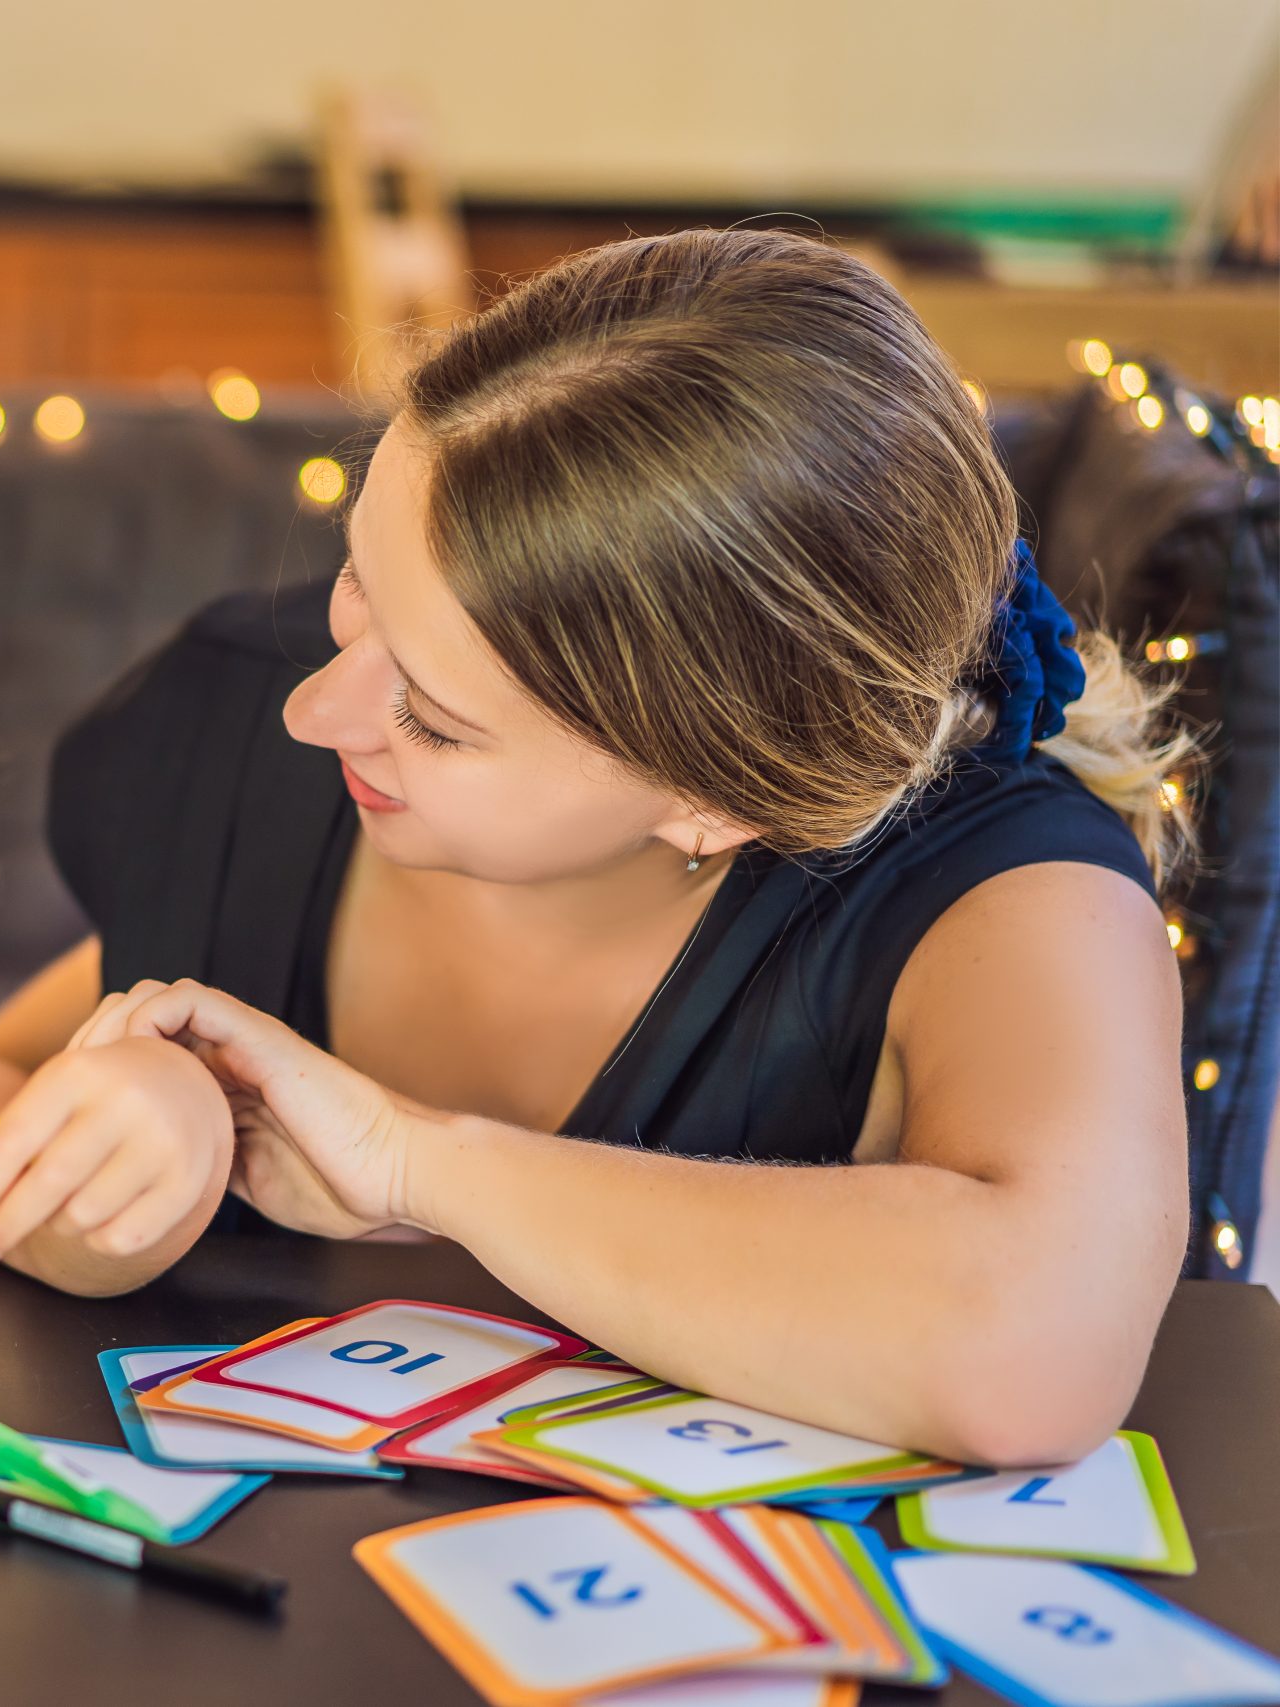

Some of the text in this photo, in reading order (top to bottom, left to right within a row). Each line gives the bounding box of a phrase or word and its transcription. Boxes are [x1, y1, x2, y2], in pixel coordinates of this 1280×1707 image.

[330, 1340, 446, 1375] 10
[666, 1419, 790, 1456] 13
[1006, 1477, 1066, 1506] 7
[1021, 1604, 1115, 1647] 8
